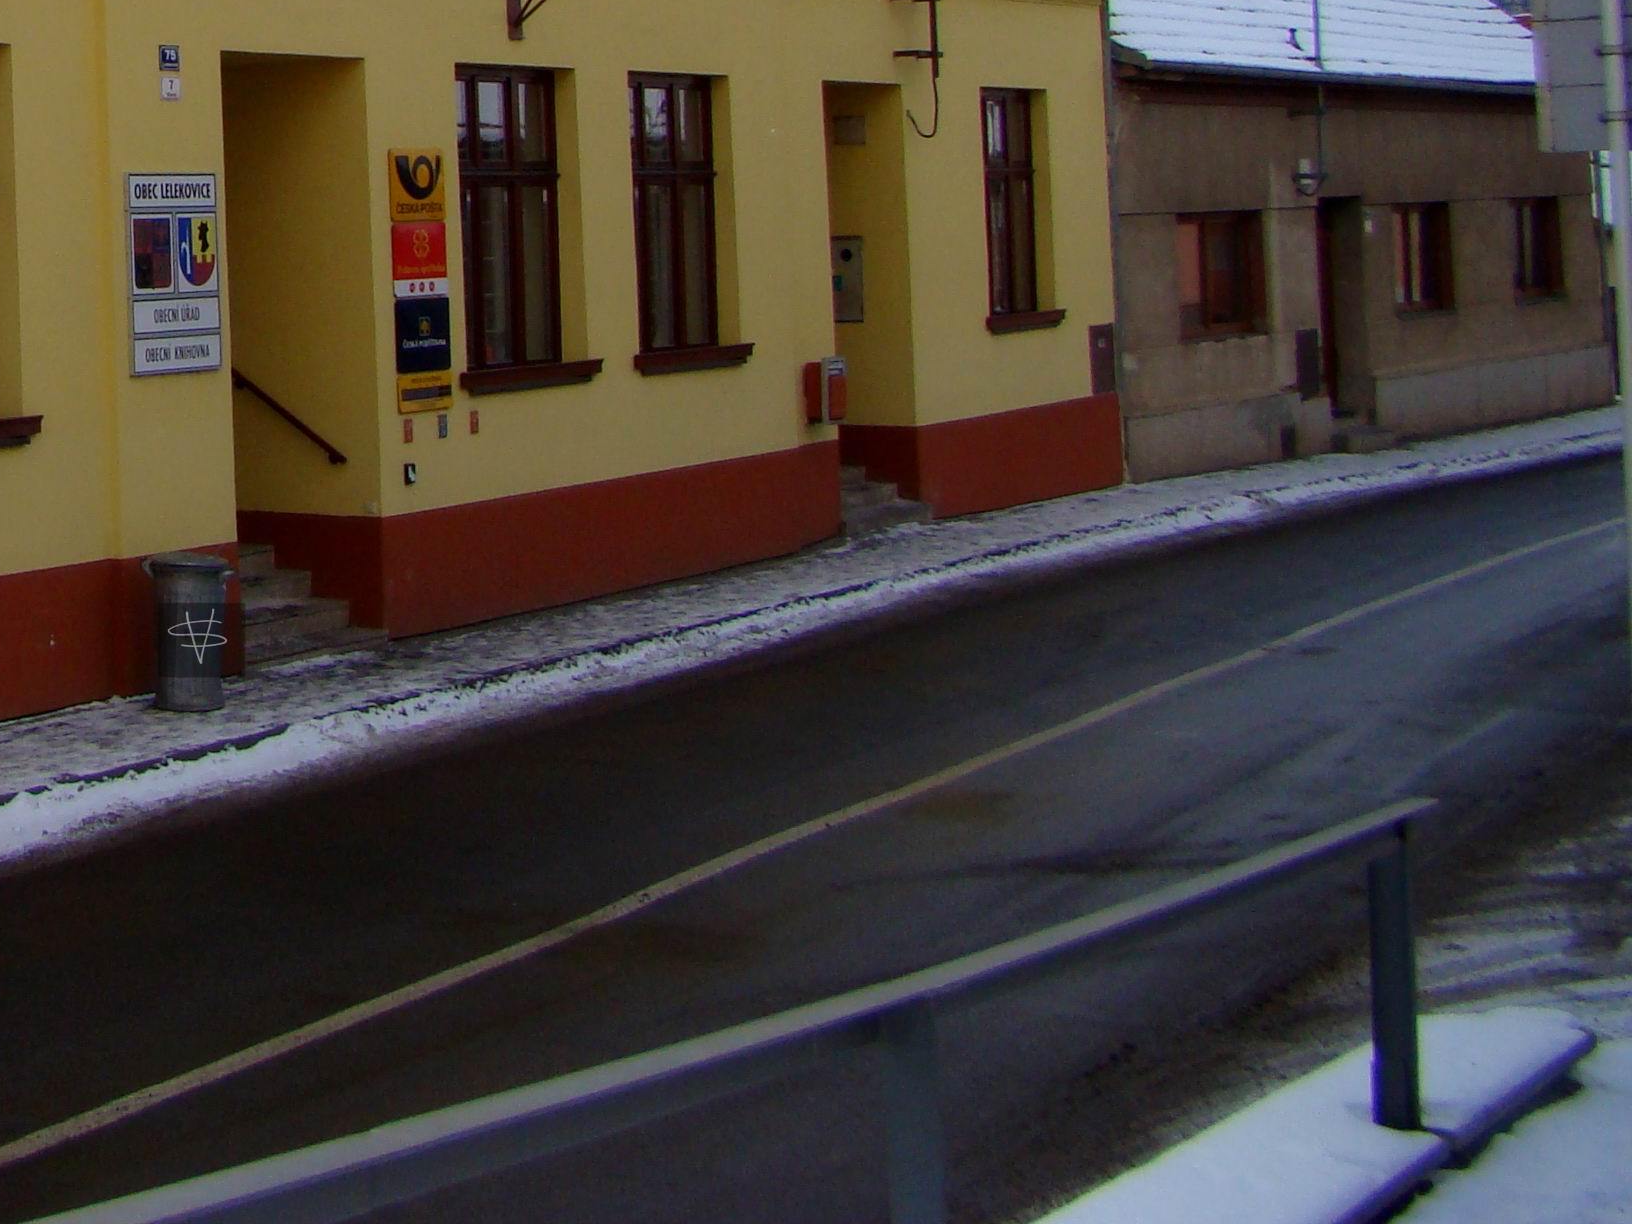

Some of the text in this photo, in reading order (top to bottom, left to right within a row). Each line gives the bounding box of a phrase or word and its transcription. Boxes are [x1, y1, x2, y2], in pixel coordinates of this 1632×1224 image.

[134, 182, 211, 199] OBEC LELEKOVICE
[153, 303, 200, 324] OBECNÍ ÚŘAD
[145, 343, 210, 363] OBECNÍ KNIHOVNA
